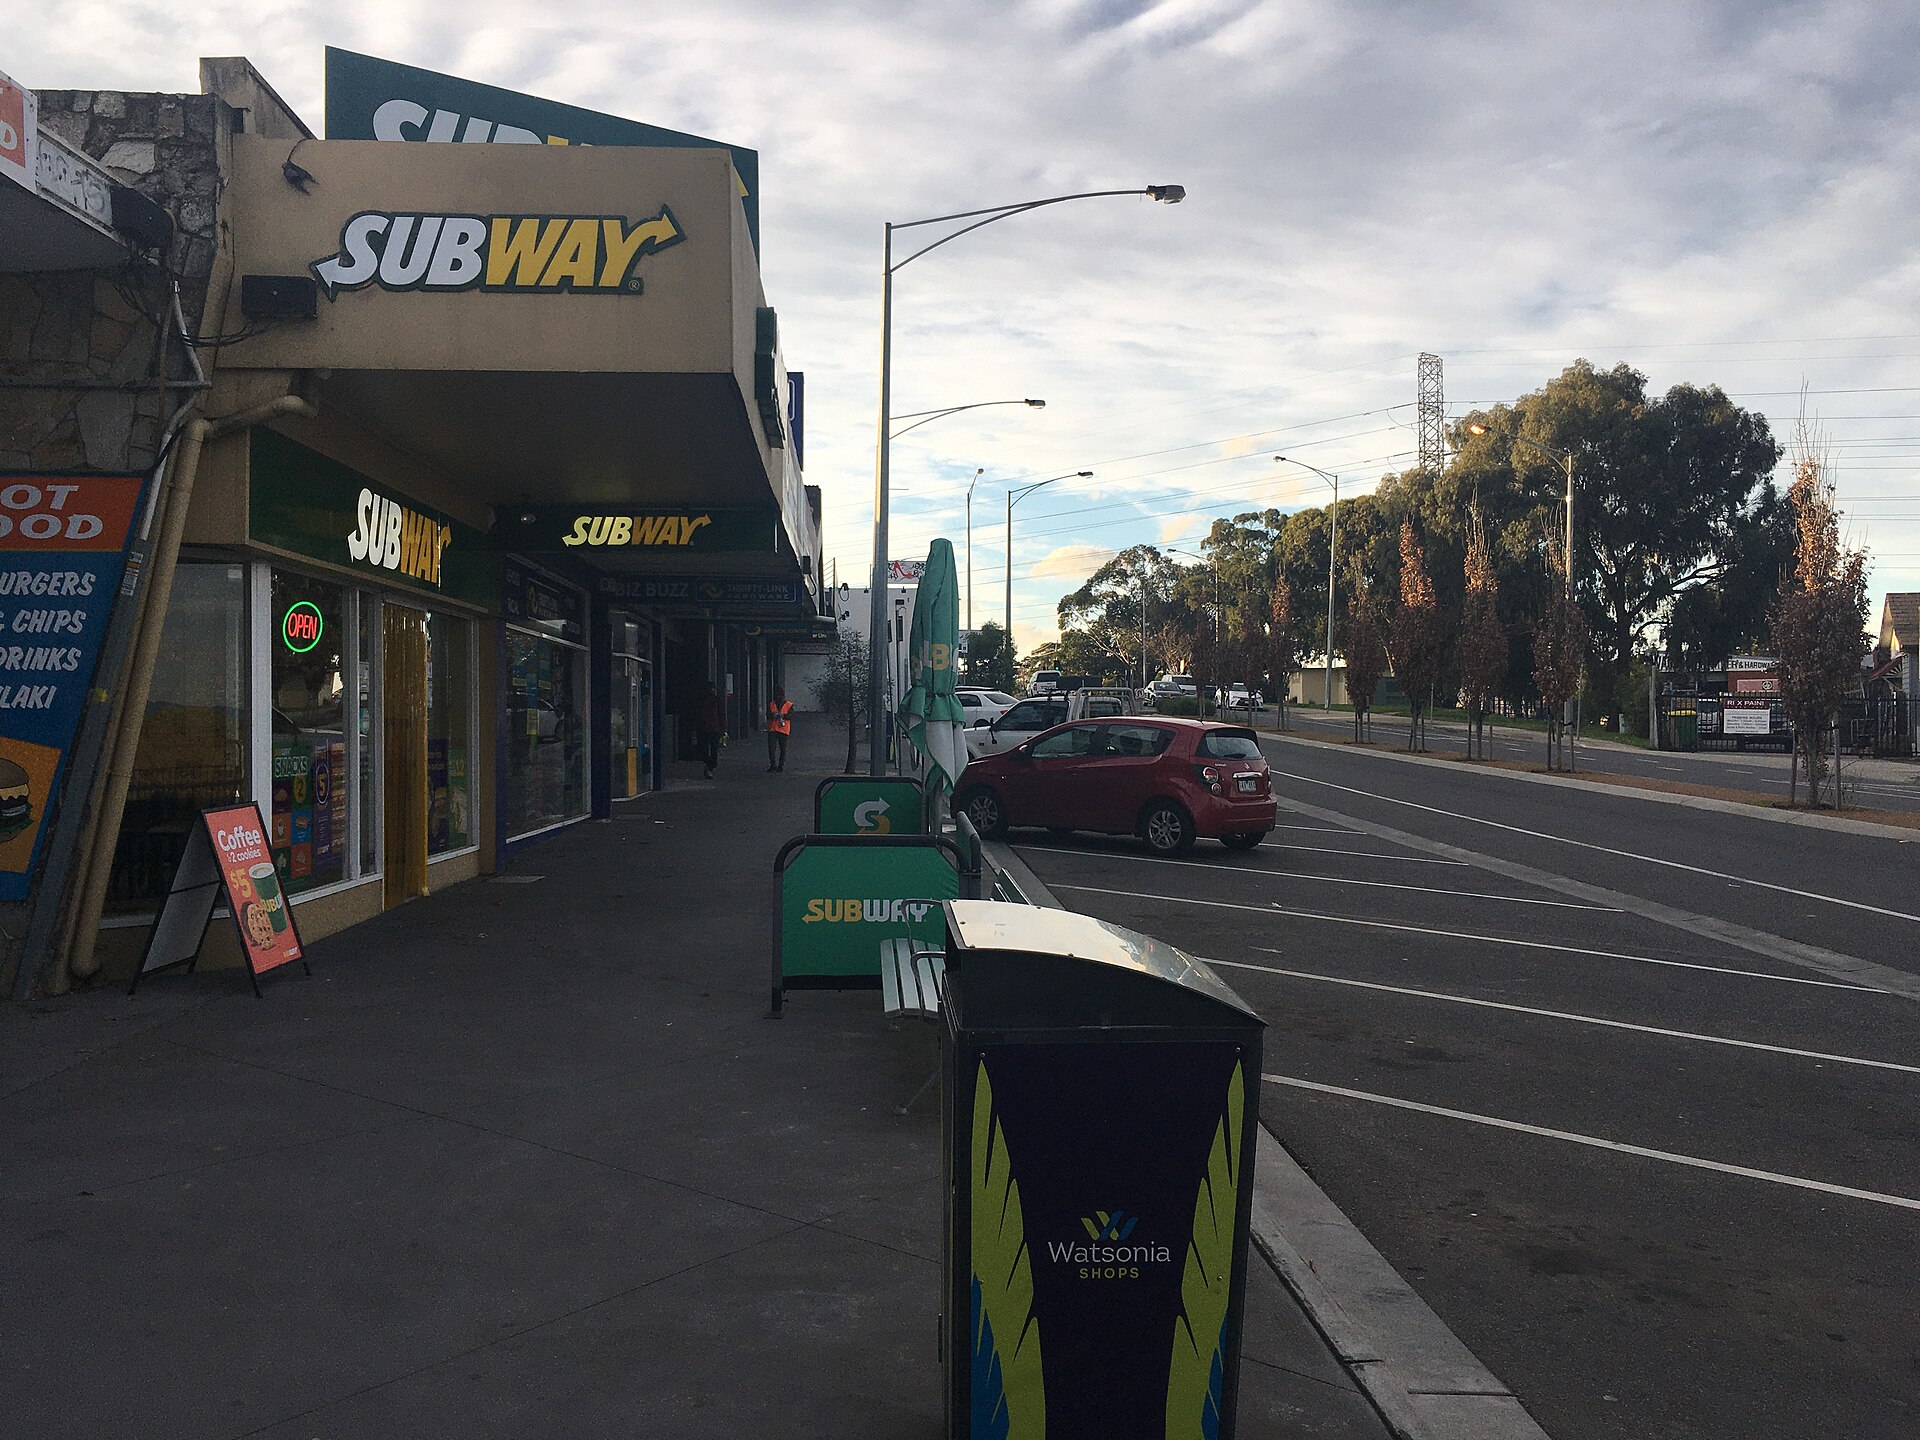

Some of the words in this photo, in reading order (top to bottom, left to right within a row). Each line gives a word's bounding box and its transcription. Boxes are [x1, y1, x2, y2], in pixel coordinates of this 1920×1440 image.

[316, 208, 679, 289] SUBWAY
[0, 484, 79, 510] OT
[348, 488, 452, 588] SUBWAY
[562, 513, 711, 547] SUBWAY
[647, 582, 689, 597] BUZZ
[11, 609, 87, 634] CHIPS
[287, 611, 318, 641] OPEN
[0, 685, 58, 710] LAKI
[217, 825, 262, 852] Coffee
[236, 847, 262, 862] cookies
[229, 868, 253, 899] $5
[801, 897, 935, 925] SUBWAY
[1047, 1240, 1172, 1264] Watsonia
[1078, 1266, 1140, 1280] SHOPS
